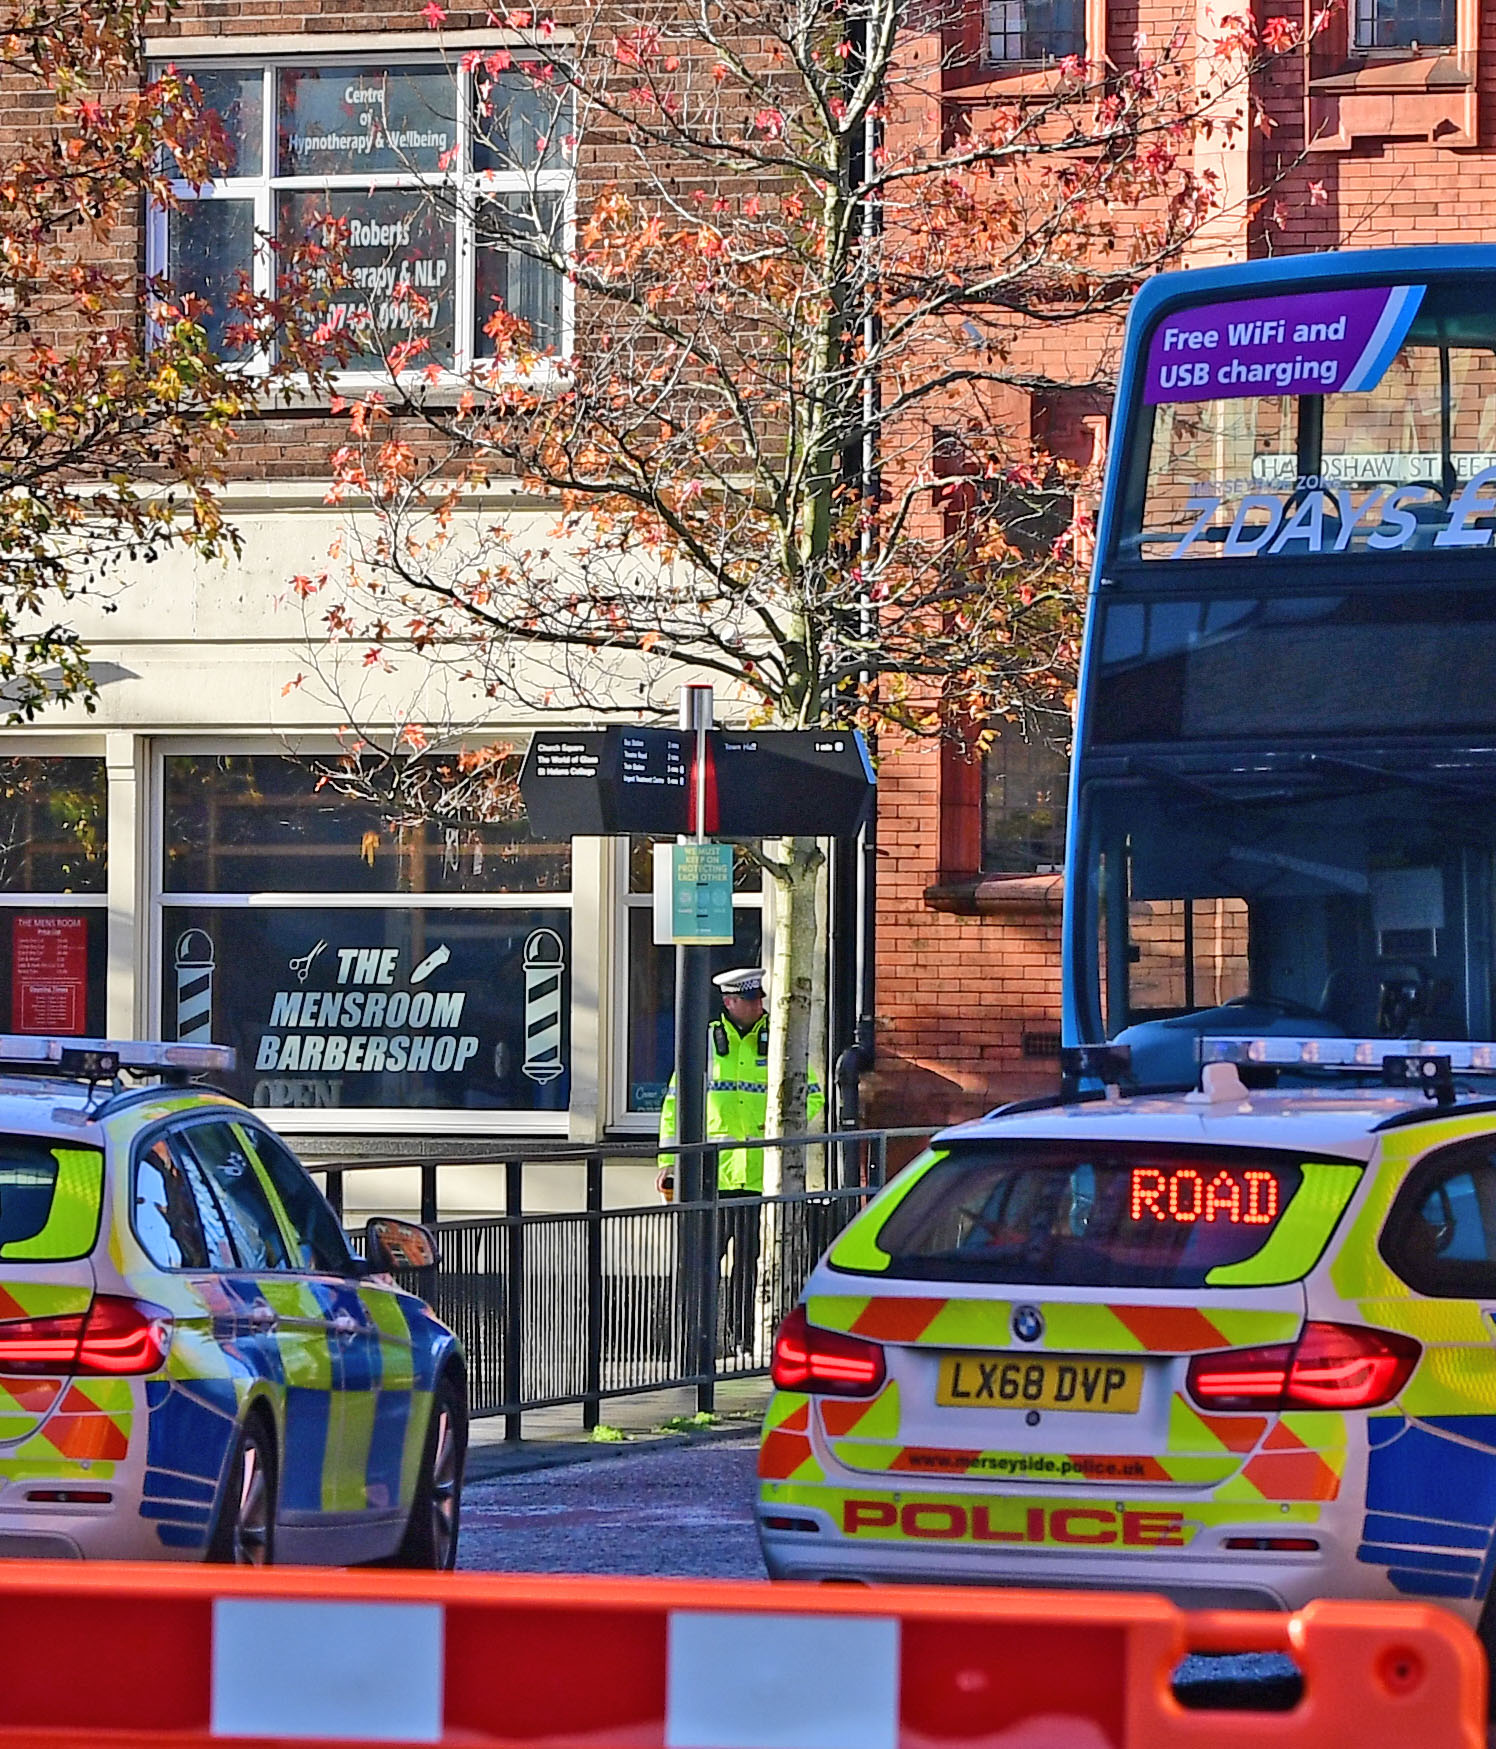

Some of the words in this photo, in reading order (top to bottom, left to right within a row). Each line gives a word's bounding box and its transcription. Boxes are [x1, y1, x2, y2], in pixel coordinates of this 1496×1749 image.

[345, 87, 384, 104] Centre
[288, 133, 374, 155] Hypnotherapy
[388, 130, 447, 151] Wellbeing
[350, 219, 410, 247] Roberts
[415, 260, 447, 287] NLP
[1163, 328, 1219, 351] Free
[1228, 320, 1286, 346] WiFi
[1293, 316, 1347, 343] and
[1160, 362, 1210, 388] USB
[1217, 355, 1338, 387] charging
[1261, 456, 1395, 479] HADSHAW
[1170, 496, 1221, 560] 7
[1223, 485, 1428, 556] DAYS
[336, 949, 399, 984] THE
[269, 992, 466, 1028] MENSROOM
[255, 1035, 479, 1072] BARBERSHOP
[253, 1079, 344, 1108] OPEN
[1131, 1168, 1279, 1224] ROAD
[951, 1361, 1042, 1402] LX68
[1055, 1366, 1126, 1405] DVP
[909, 1455, 1144, 1476] www.merseyside.police.uk
[842, 1500, 1185, 1548] POLICE
